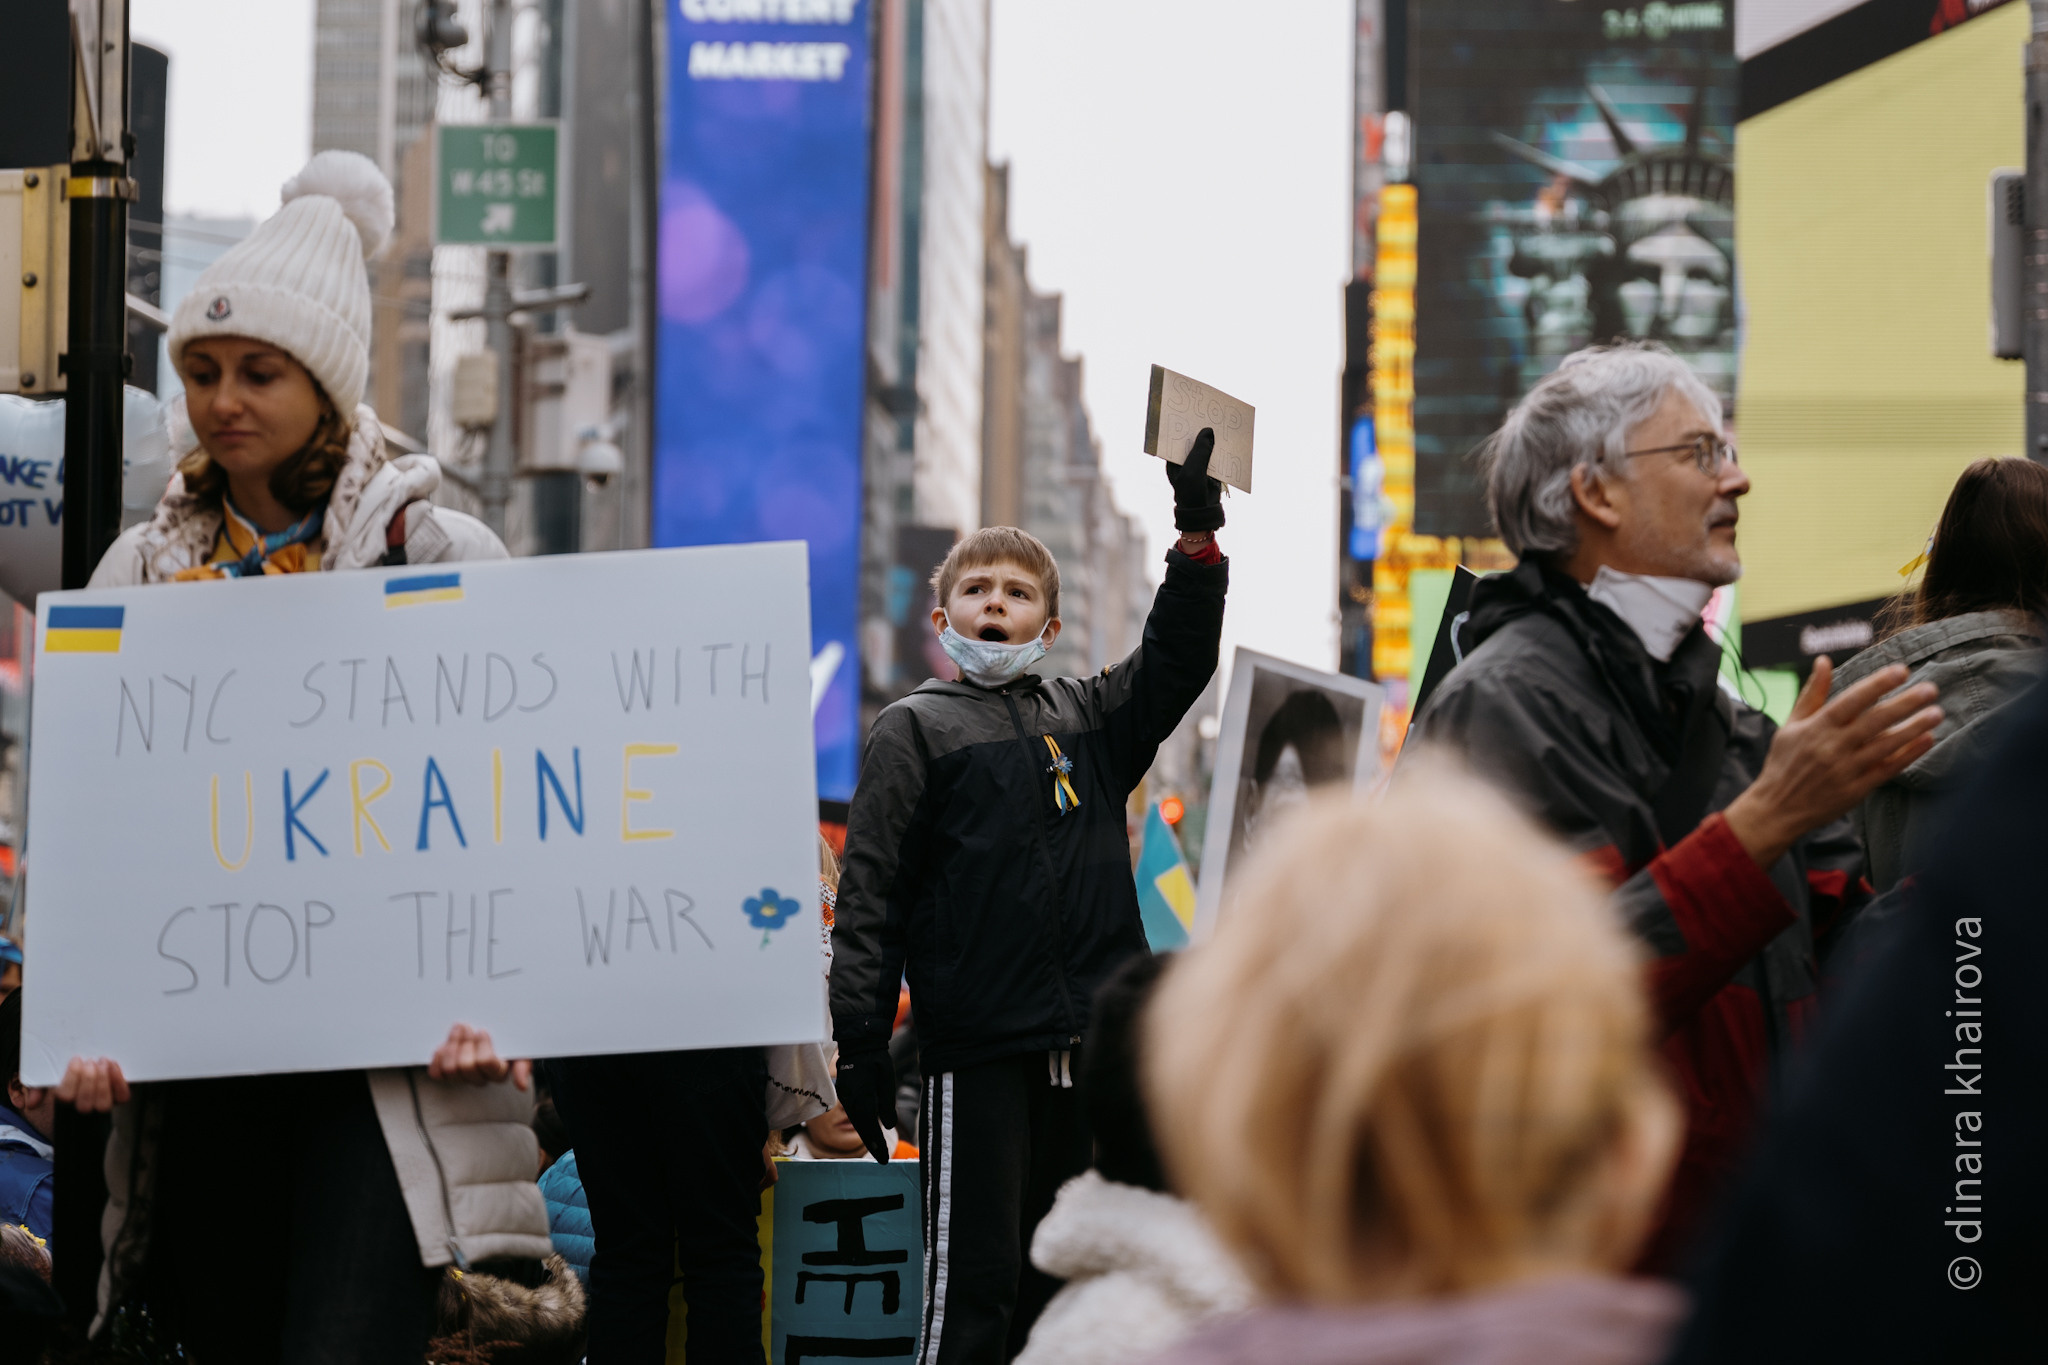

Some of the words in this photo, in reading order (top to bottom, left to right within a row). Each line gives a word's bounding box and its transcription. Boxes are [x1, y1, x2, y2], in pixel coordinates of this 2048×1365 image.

[688, 41, 850, 81] MARKET
[482, 133, 517, 163] TO
[1167, 377, 1241, 441] Stop
[1166, 414, 1241, 482] Pin
[115, 668, 238, 757] NYC
[289, 651, 558, 728] STANDS
[611, 643, 771, 713] WITH
[210, 743, 679, 871] UKRAINE
[157, 900, 336, 995] STOP
[388, 888, 524, 983] THE
[575, 887, 715, 967] WAR
